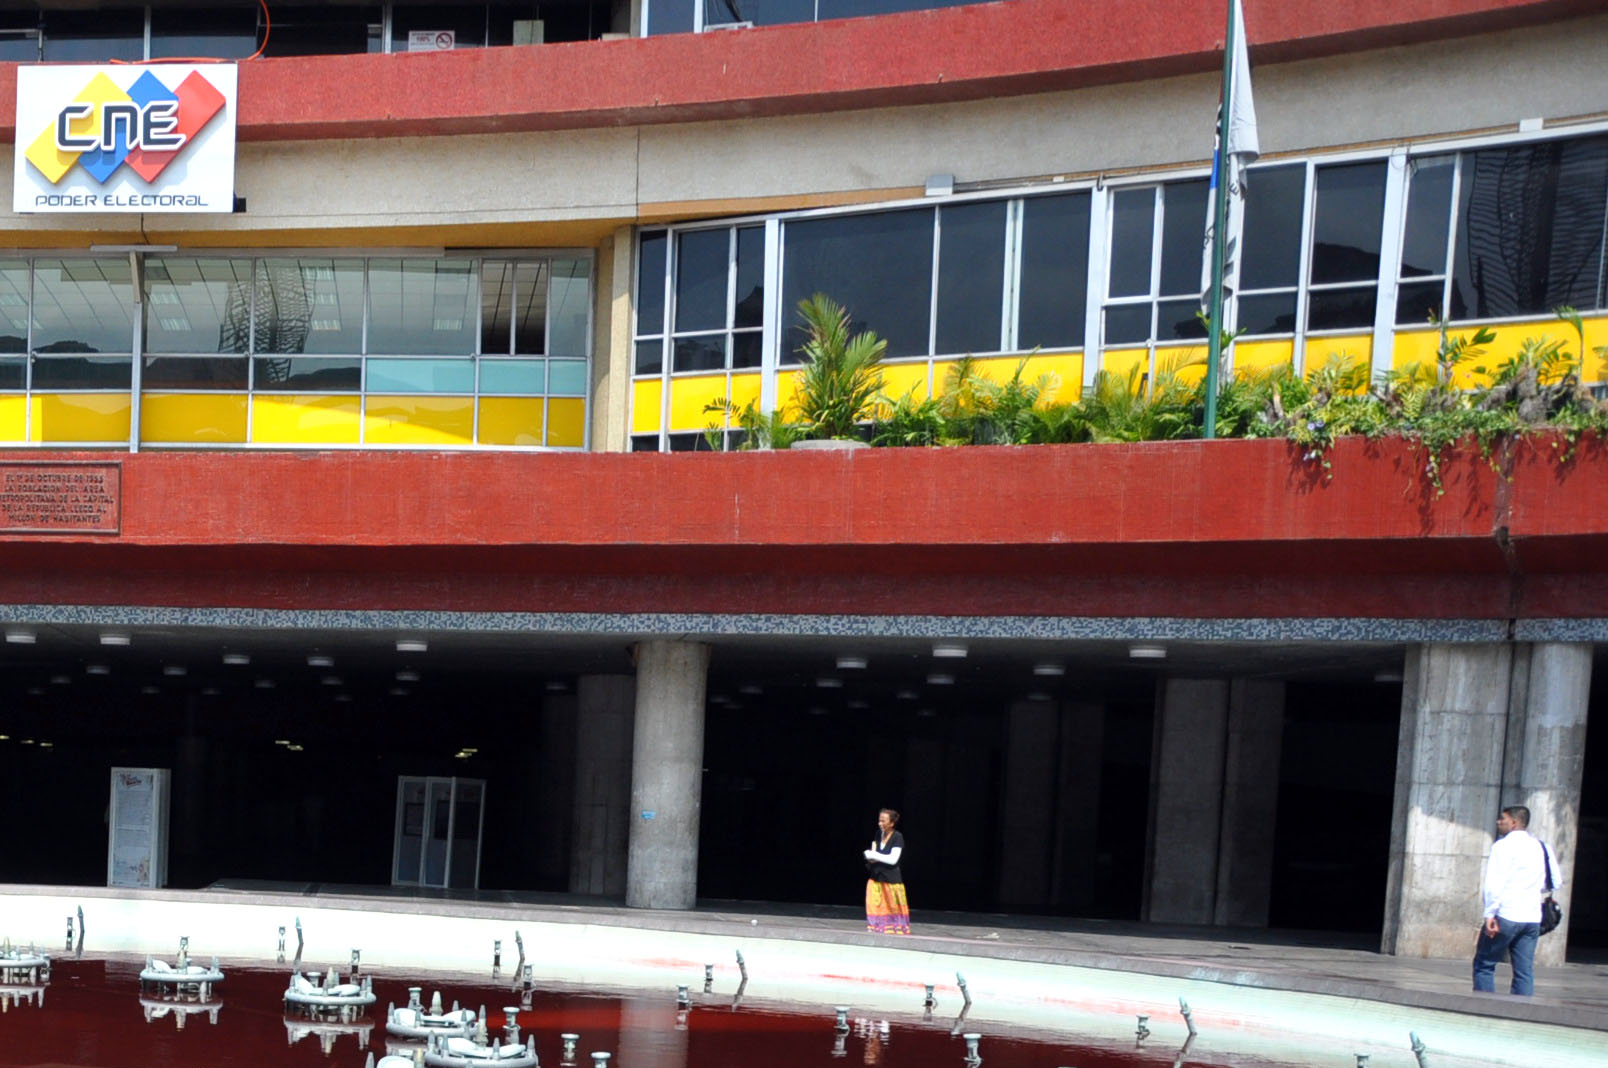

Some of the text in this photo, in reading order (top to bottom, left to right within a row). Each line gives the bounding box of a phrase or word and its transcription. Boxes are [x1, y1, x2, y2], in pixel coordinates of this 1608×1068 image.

[56, 102, 186, 150] CNE
[35, 194, 209, 207] PODER ELECTORAL
[6, 474, 14, 482] EL
[25, 474, 34, 482] DE
[37, 474, 71, 482] OCTUBRE
[5, 484, 14, 493] LA
[83, 495, 114, 504] CAPITAL
